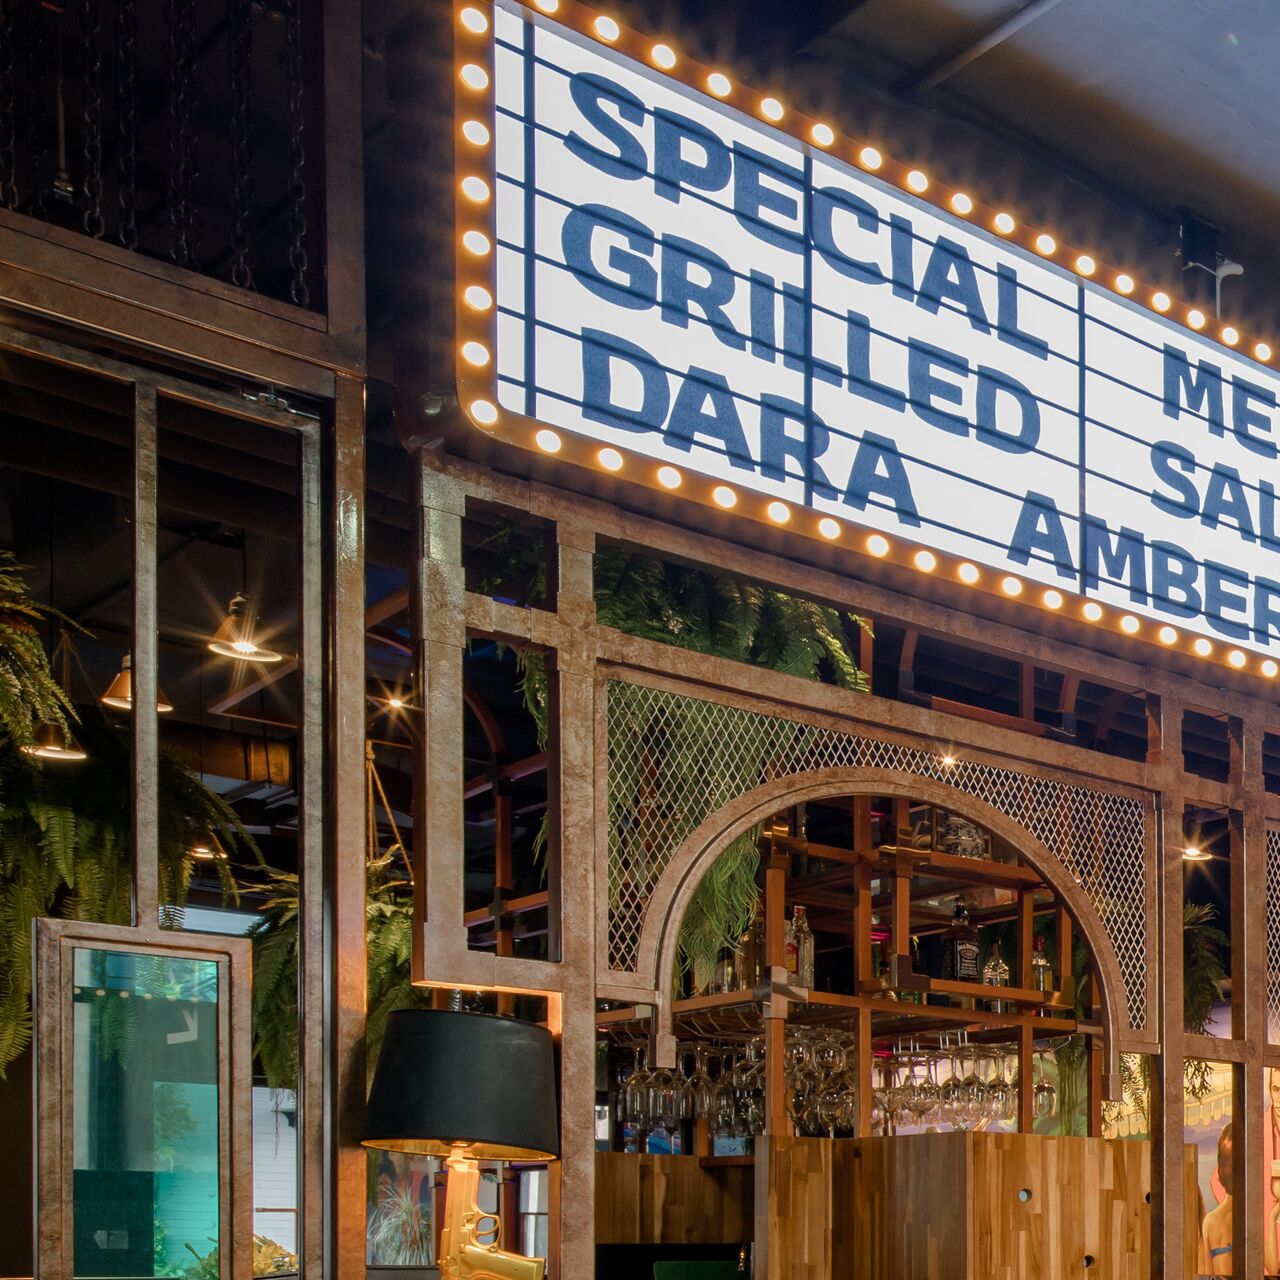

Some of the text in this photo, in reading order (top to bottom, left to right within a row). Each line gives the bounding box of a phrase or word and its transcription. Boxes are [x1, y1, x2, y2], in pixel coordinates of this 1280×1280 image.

[561, 203, 1042, 455] GRILLED
[562, 72, 1049, 361] SPECIAL
[581, 327, 921, 528] DARA
